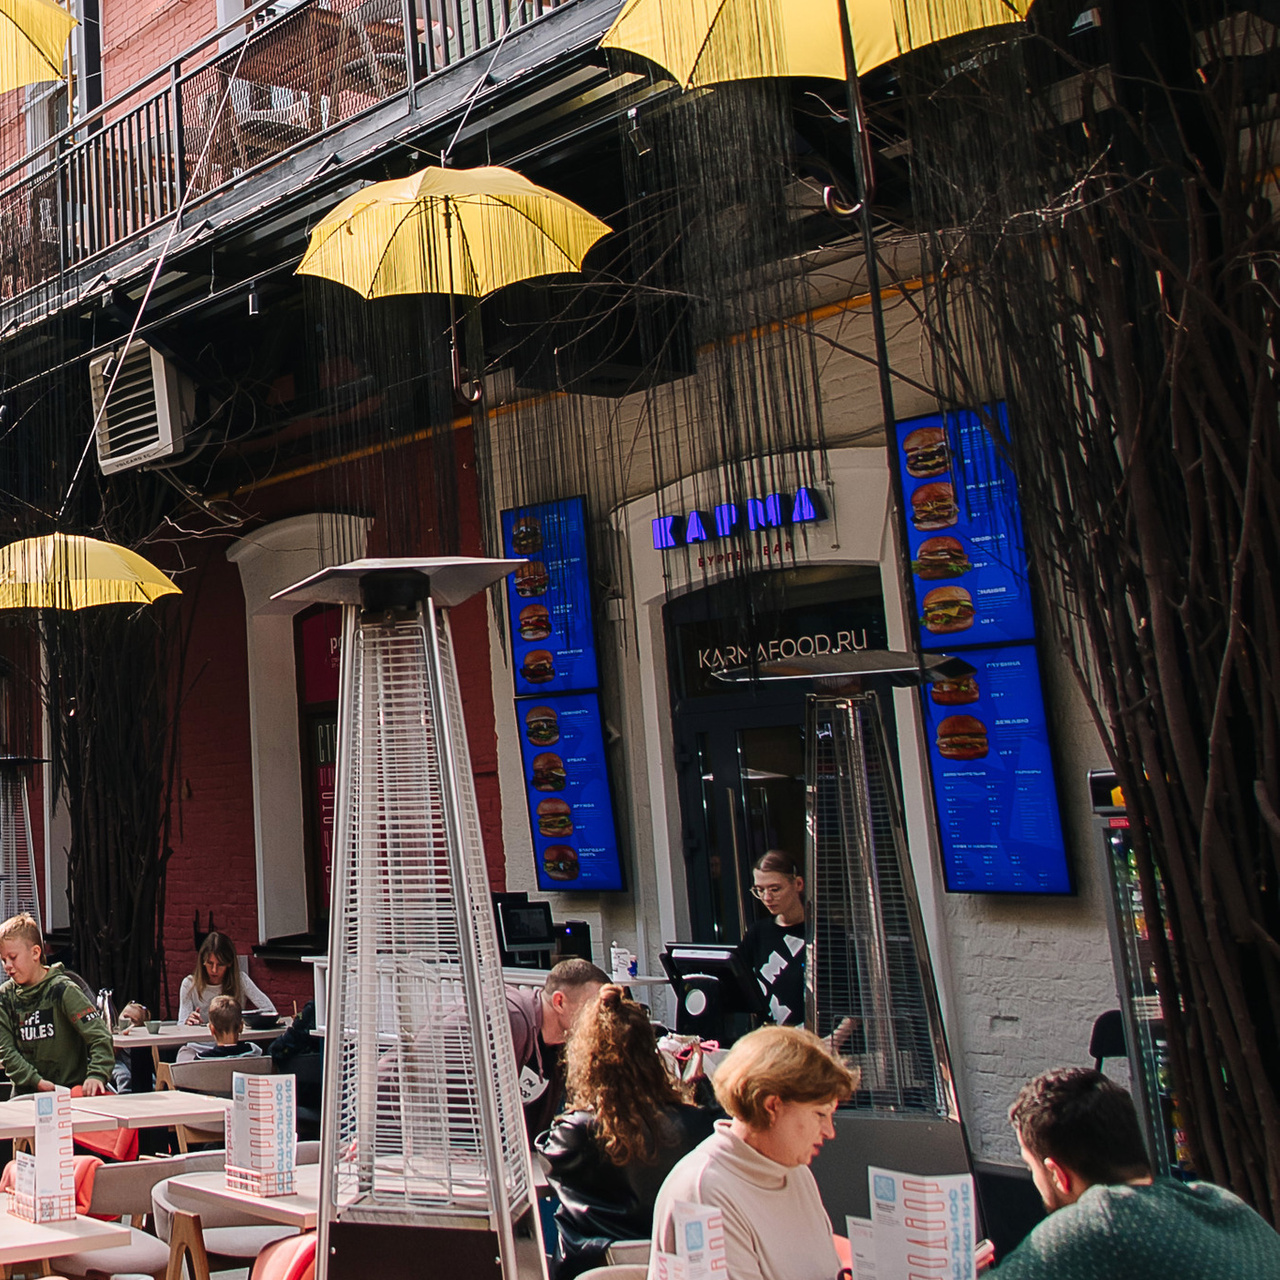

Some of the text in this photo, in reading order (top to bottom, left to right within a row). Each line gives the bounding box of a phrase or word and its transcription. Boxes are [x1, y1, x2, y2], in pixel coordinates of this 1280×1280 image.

[652, 487, 816, 550] КАРМА
[763, 542, 794, 556] БАР
[699, 629, 868, 669] KARMAFOOD.RU
